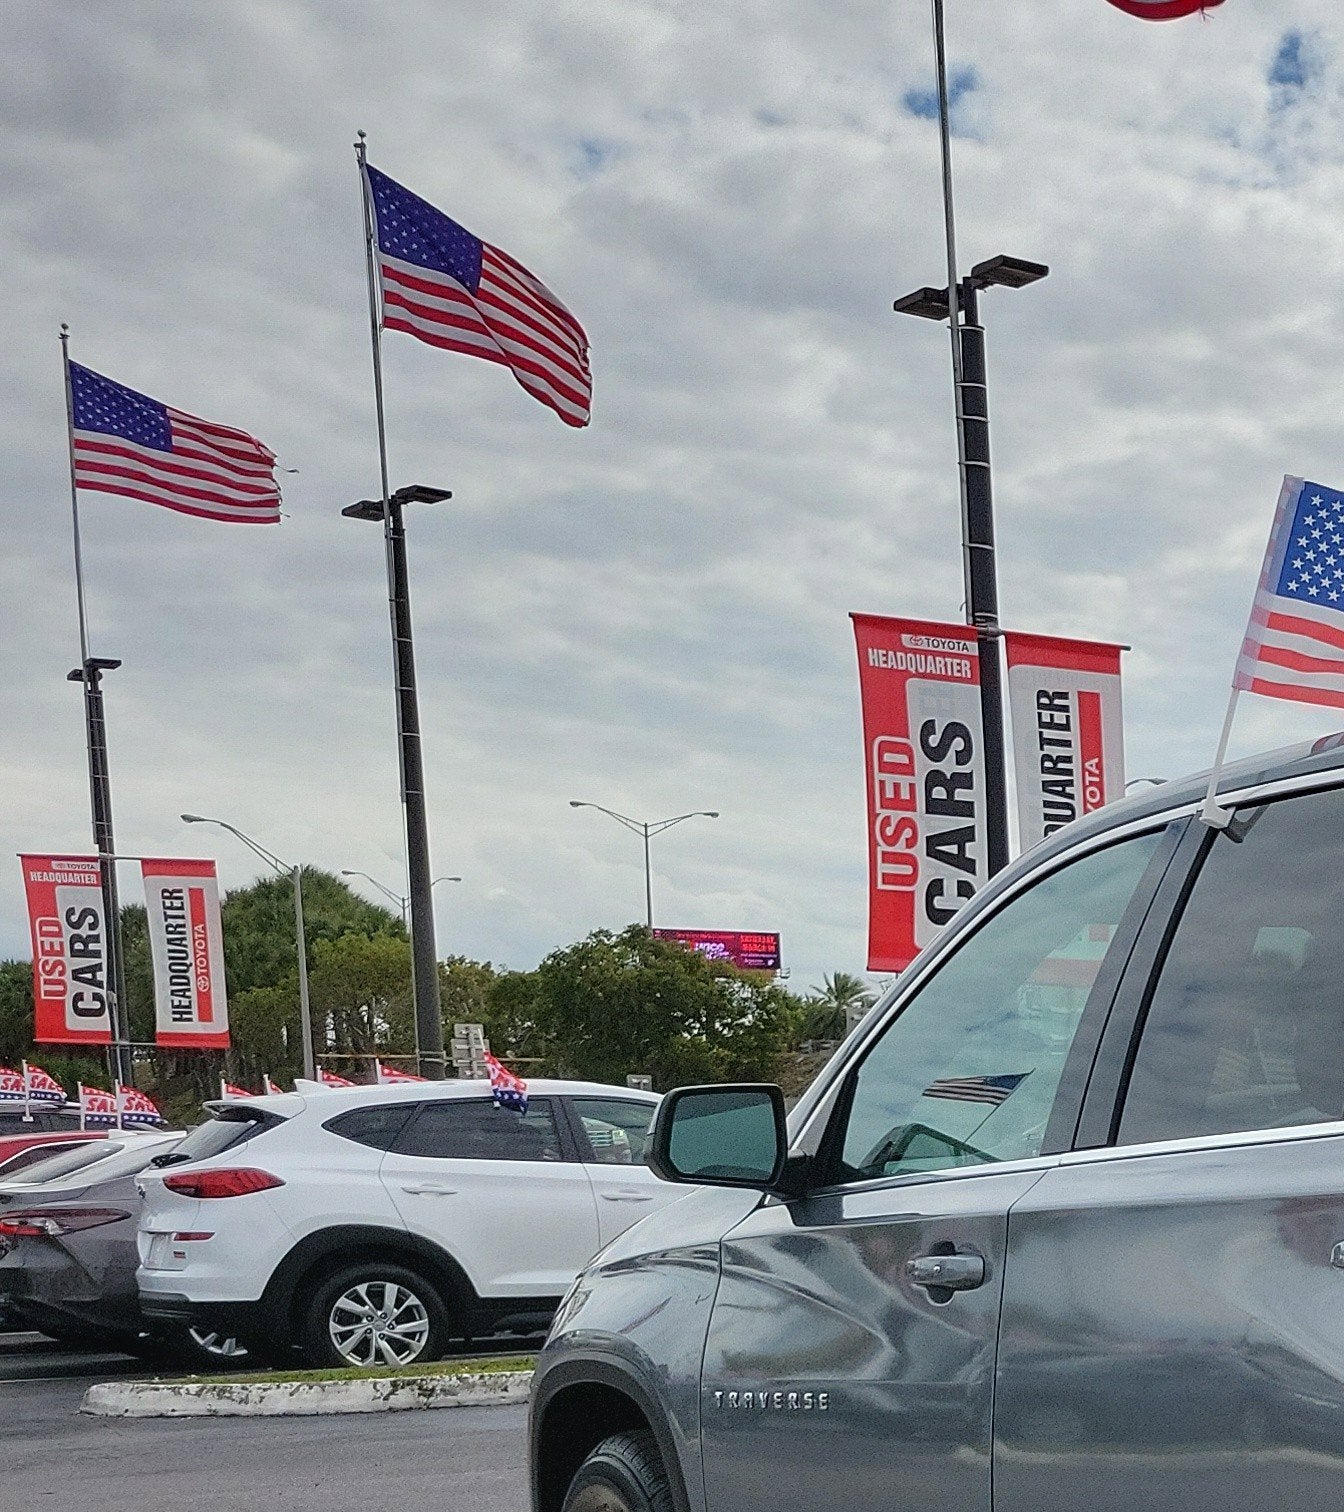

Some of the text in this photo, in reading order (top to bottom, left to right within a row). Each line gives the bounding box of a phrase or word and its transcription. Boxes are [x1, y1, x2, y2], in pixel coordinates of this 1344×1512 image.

[867, 648, 972, 679] HEADQUARTER
[924, 637, 970, 653] TOYOTA
[874, 736, 920, 892] USED
[919, 718, 978, 927] CARS
[30, 871, 97, 884] HEADQUARTER
[67, 862, 96, 870] TOYOTA
[36, 916, 69, 1000] USED
[65, 905, 107, 1018] CARS
[161, 887, 194, 1023] HEADQUARTER
[193, 923, 208, 974] TOYOTA
[714, 1391, 830, 1411] TRAVERSE
